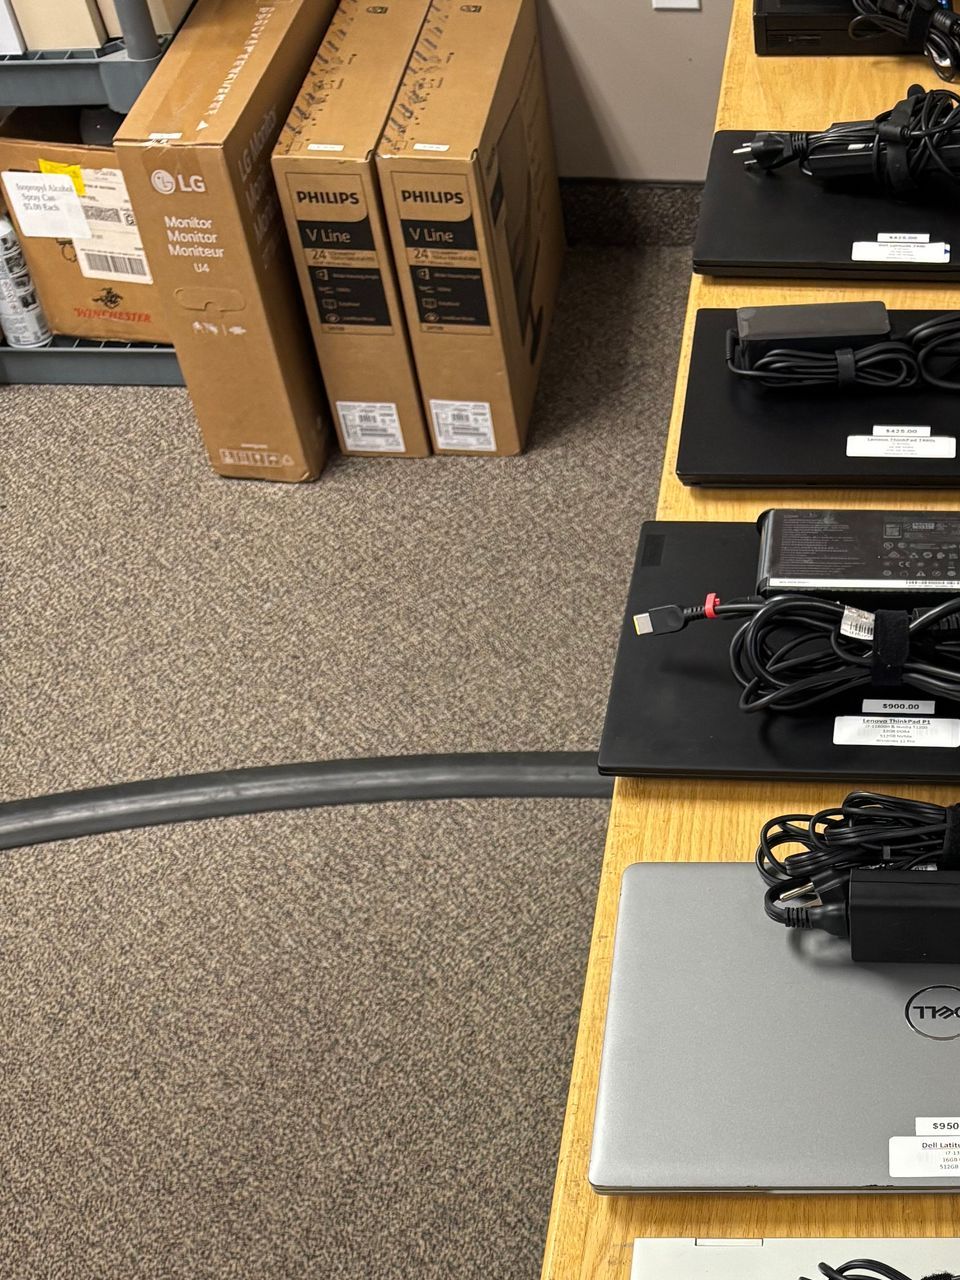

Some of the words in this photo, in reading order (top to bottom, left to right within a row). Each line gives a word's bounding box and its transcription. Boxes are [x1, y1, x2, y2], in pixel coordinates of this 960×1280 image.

[178, 174, 206, 192] LG
[22, 194, 41, 202] Spray
[296, 190, 360, 204] PHILIPS
[401, 190, 464, 204] PHILIPS
[164, 216, 212, 228] Monitor
[166, 230, 218, 243] Monitor
[306, 228, 318, 241] V
[321, 229, 351, 243] Line
[408, 228, 420, 240] V
[424, 228, 454, 242] Line
[168, 244, 224, 258] Moniteur
[312, 249, 327, 260] 24
[414, 248, 429, 259] 24
[194, 262, 210, 272] U4
[74, 307, 152, 324] WINCHESTER
